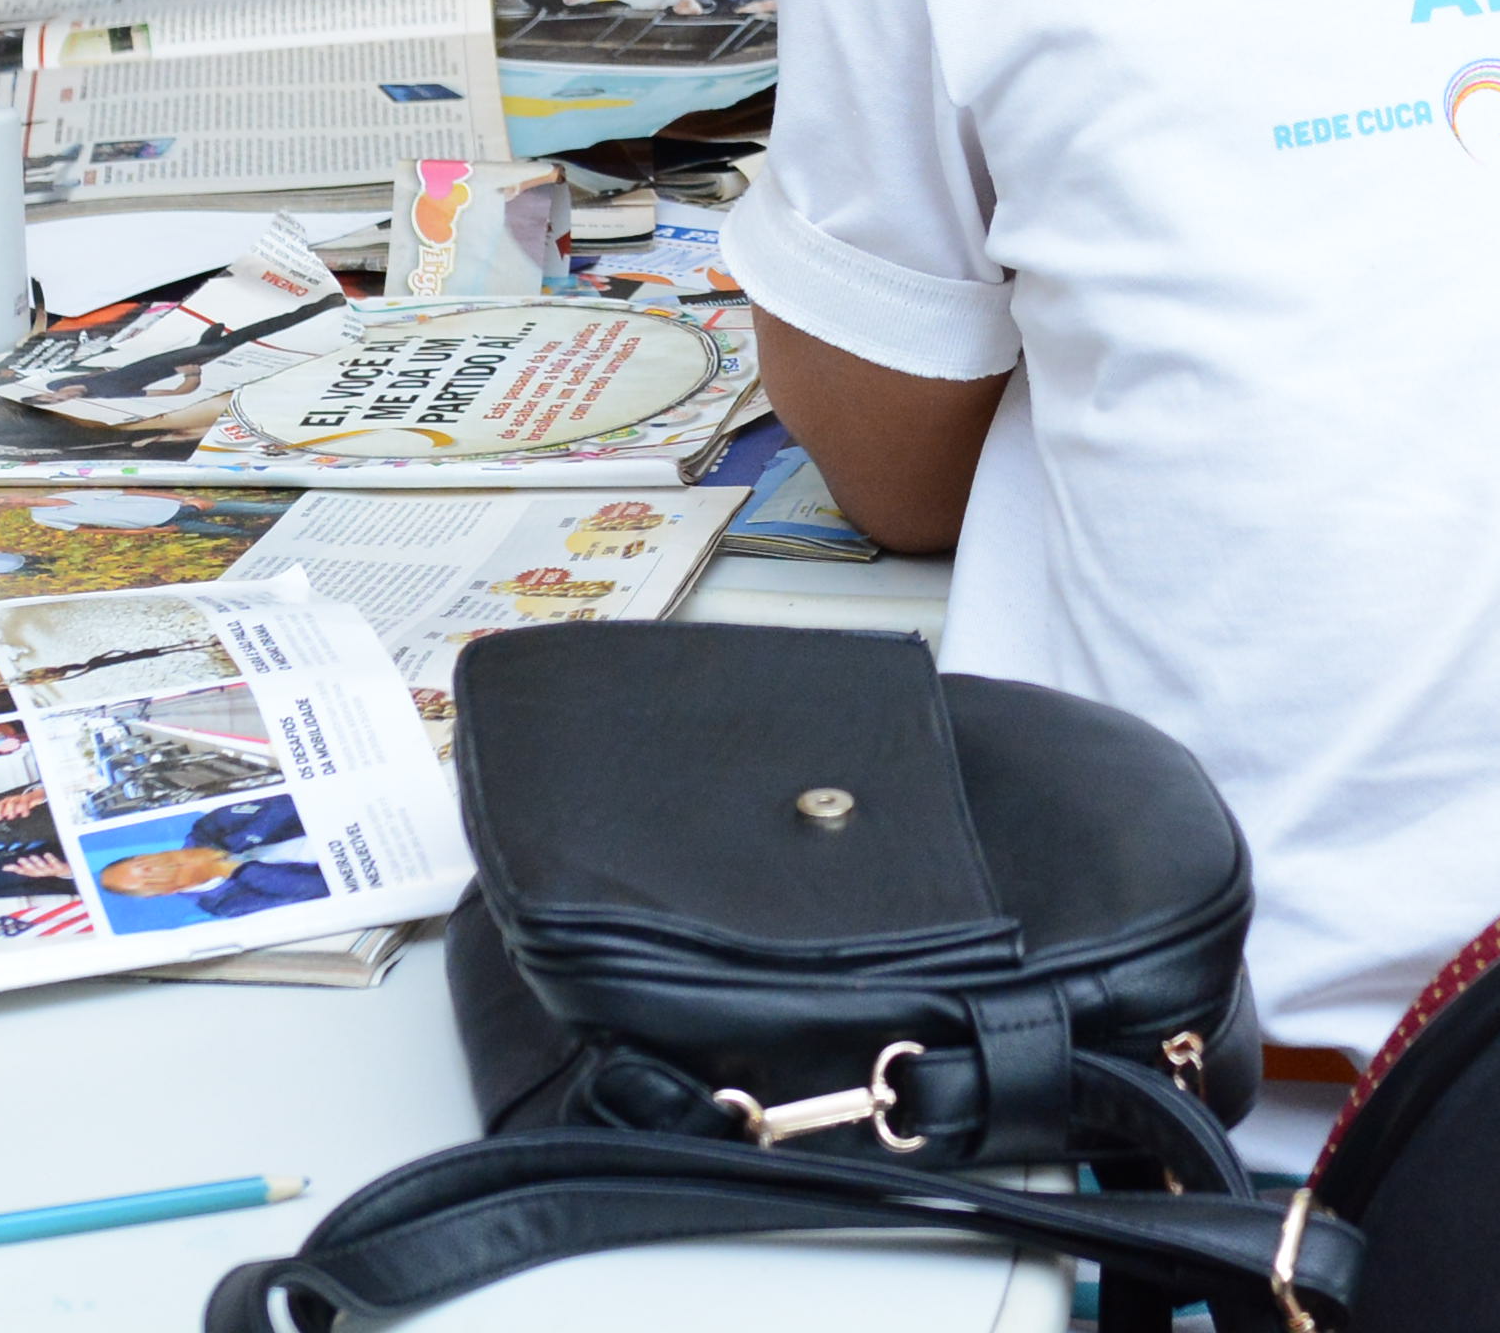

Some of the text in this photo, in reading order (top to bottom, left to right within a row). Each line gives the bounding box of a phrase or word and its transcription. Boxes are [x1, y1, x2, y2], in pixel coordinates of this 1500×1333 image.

[1273, 100, 1433, 150] REDE CUCA
[261, 270, 308, 297] CINEMA
[319, 358, 394, 400] VOCÊ
[362, 338, 466, 420] ME DÁ UM
[416, 354, 506, 423] PARTIDO
[483, 402, 513, 420] Está
[502, 365, 540, 400] passando
[527, 354, 549, 364] da
[300, 405, 362, 426] EI,
[497, 429, 519, 440] de
[510, 400, 540, 428] acabar
[531, 382, 554, 399] com
[521, 402, 570, 441] brasileira,
[569, 403, 593, 420] com
[278, 716, 315, 780] OS DESAFIOS
[295, 697, 337, 776] DA MOBILIDADE
[328, 840, 360, 894] MINEIRAÇO
